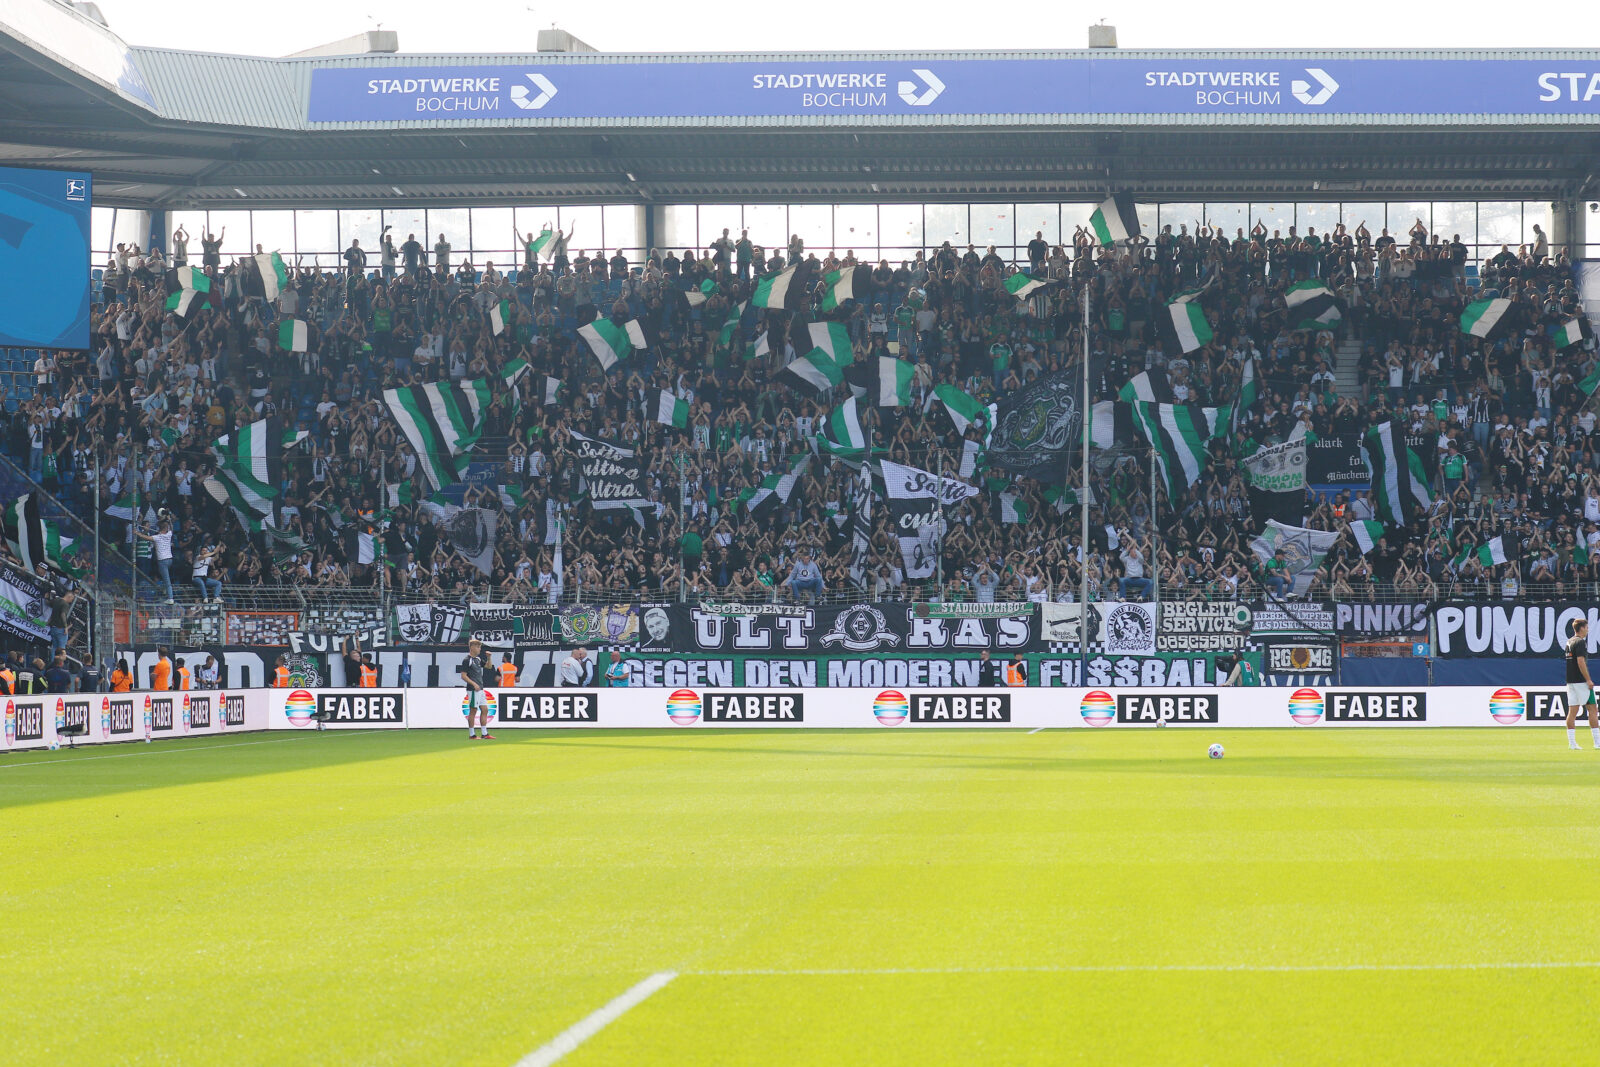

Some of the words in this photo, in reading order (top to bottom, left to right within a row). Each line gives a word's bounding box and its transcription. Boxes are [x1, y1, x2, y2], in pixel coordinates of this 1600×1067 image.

[367, 77, 500, 94] STADTWERKE
[752, 73, 887, 89] STADTWERKE
[1145, 71, 1280, 87] STADTWERKE
[416, 96, 499, 112] BOCHUM
[803, 92, 887, 107] BOCHUM
[1196, 90, 1281, 105] BOCHUM
[1403, 435, 1424, 446] hite
[472, 609, 514, 622] VITUS
[1162, 601, 1236, 618] BEGLEIT
[1162, 617, 1234, 633] SERVICE
[474, 630, 514, 642] CREW
[1417, 644, 1425, 654] 9
[627, 659, 734, 688] GEGEN
[745, 659, 817, 688] DEN
[153, 703, 172, 728] FABER
[191, 702, 209, 726] FABER
[227, 700, 244, 724] FABER
[324, 696, 396, 720] FABER
[506, 696, 589, 719] FABER
[711, 696, 795, 719] FABER
[918, 697, 1003, 720] FABER
[1125, 697, 1210, 720] FABER
[1333, 695, 1418, 718] FABER
[17, 708, 41, 736] FABER
[111, 704, 132, 731] FABER
